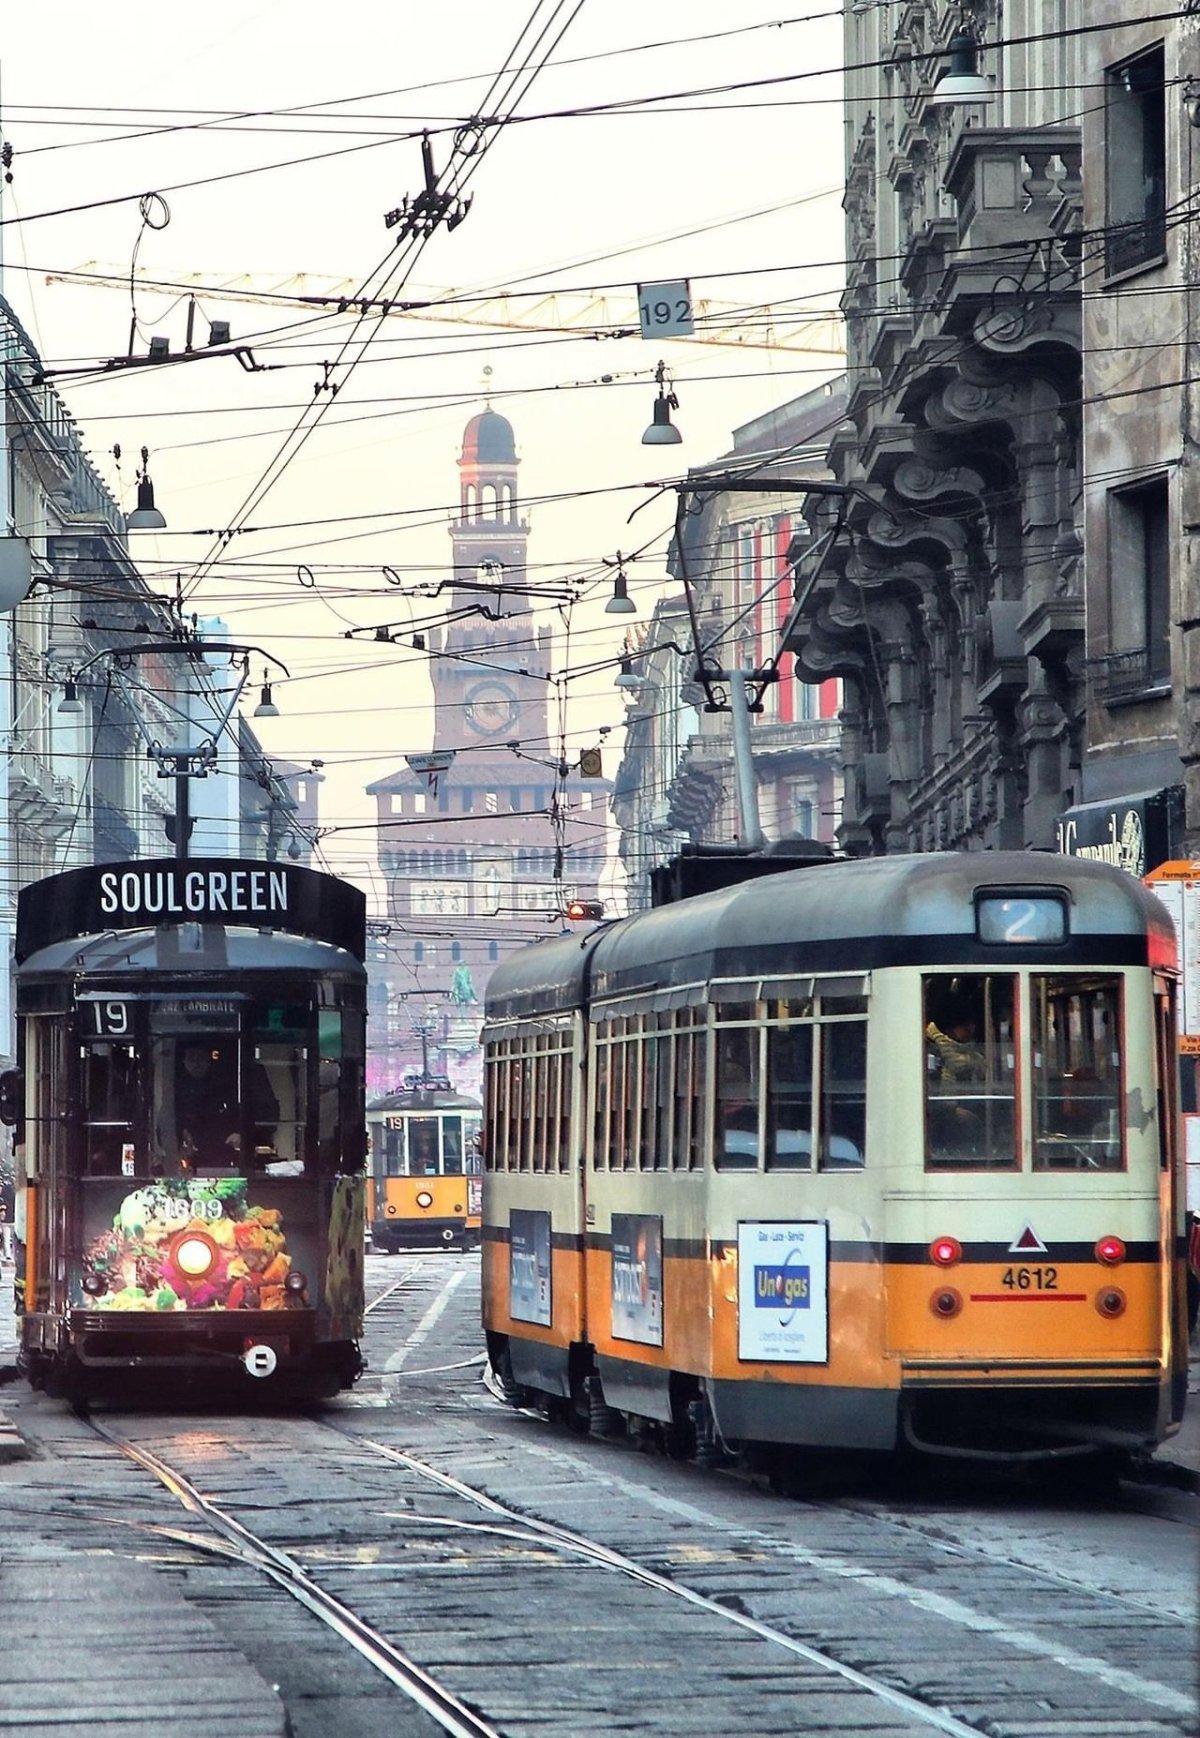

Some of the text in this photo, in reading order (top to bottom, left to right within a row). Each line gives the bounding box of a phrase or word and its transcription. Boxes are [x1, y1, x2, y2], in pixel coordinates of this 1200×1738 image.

[641, 300, 691, 325] 192
[100, 871, 288, 912] SOULGREEN
[1002, 901, 1037, 943] 2
[94, 1001, 127, 1033] 19
[390, 1118, 402, 1129] 19
[1002, 1268, 1057, 1289] 4612
